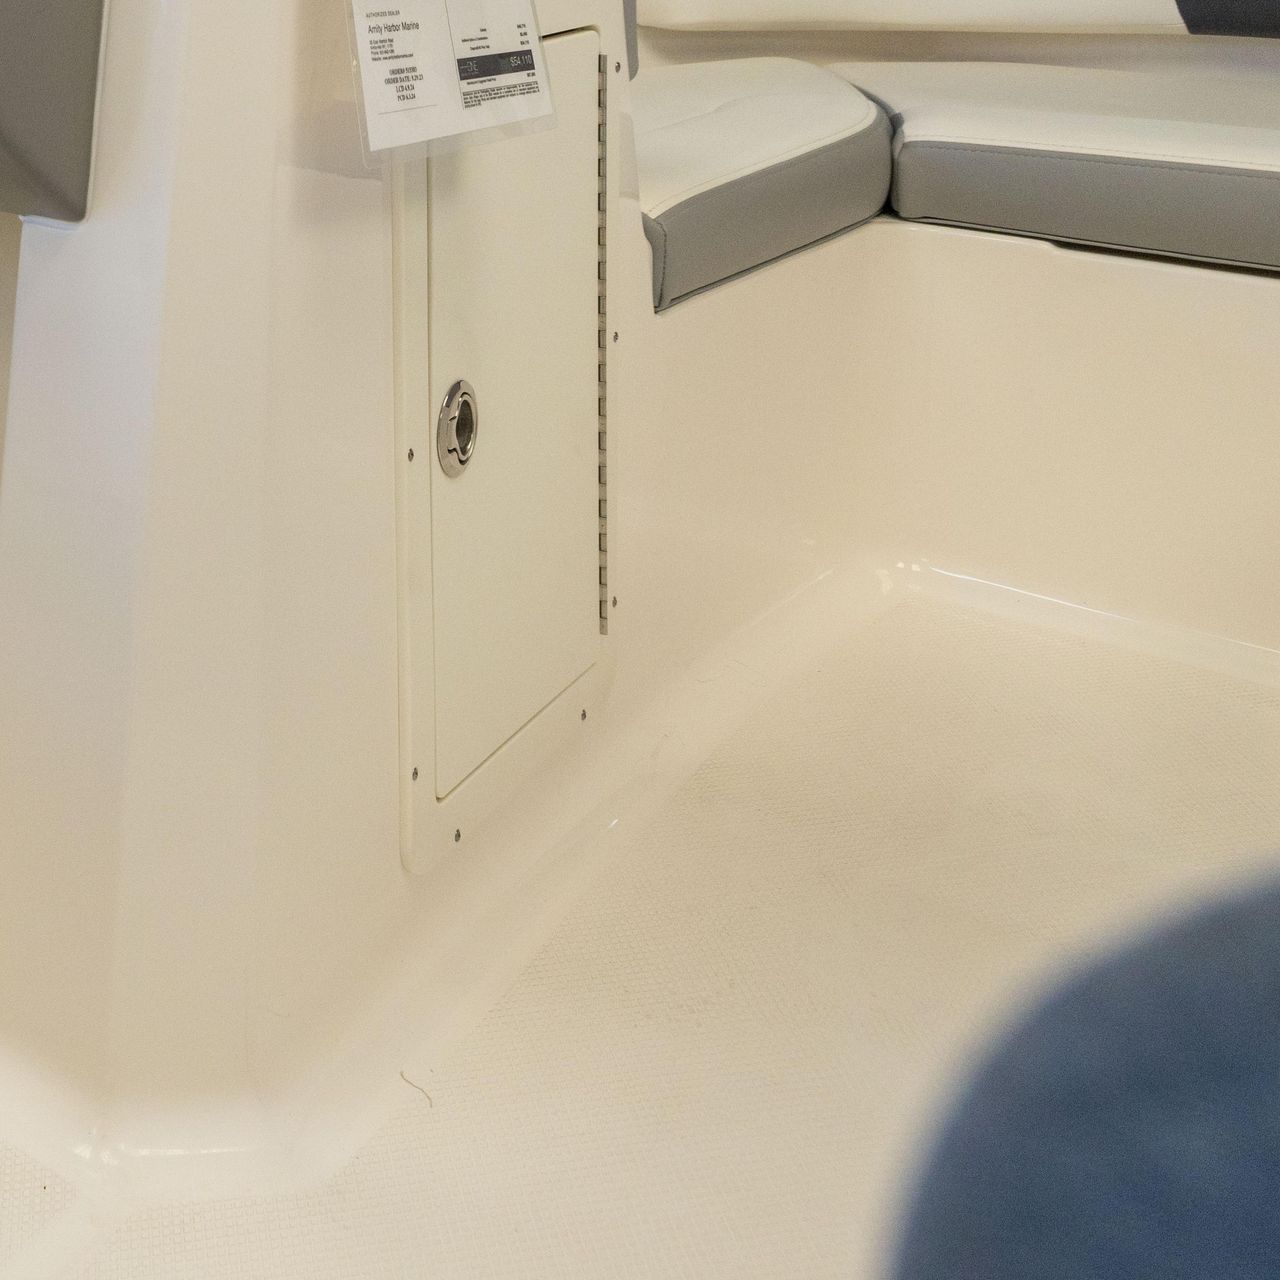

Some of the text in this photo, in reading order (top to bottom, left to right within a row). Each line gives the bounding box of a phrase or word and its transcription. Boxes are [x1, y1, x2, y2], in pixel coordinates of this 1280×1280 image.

[368, 21, 420, 35] Amity Harbor Marine
